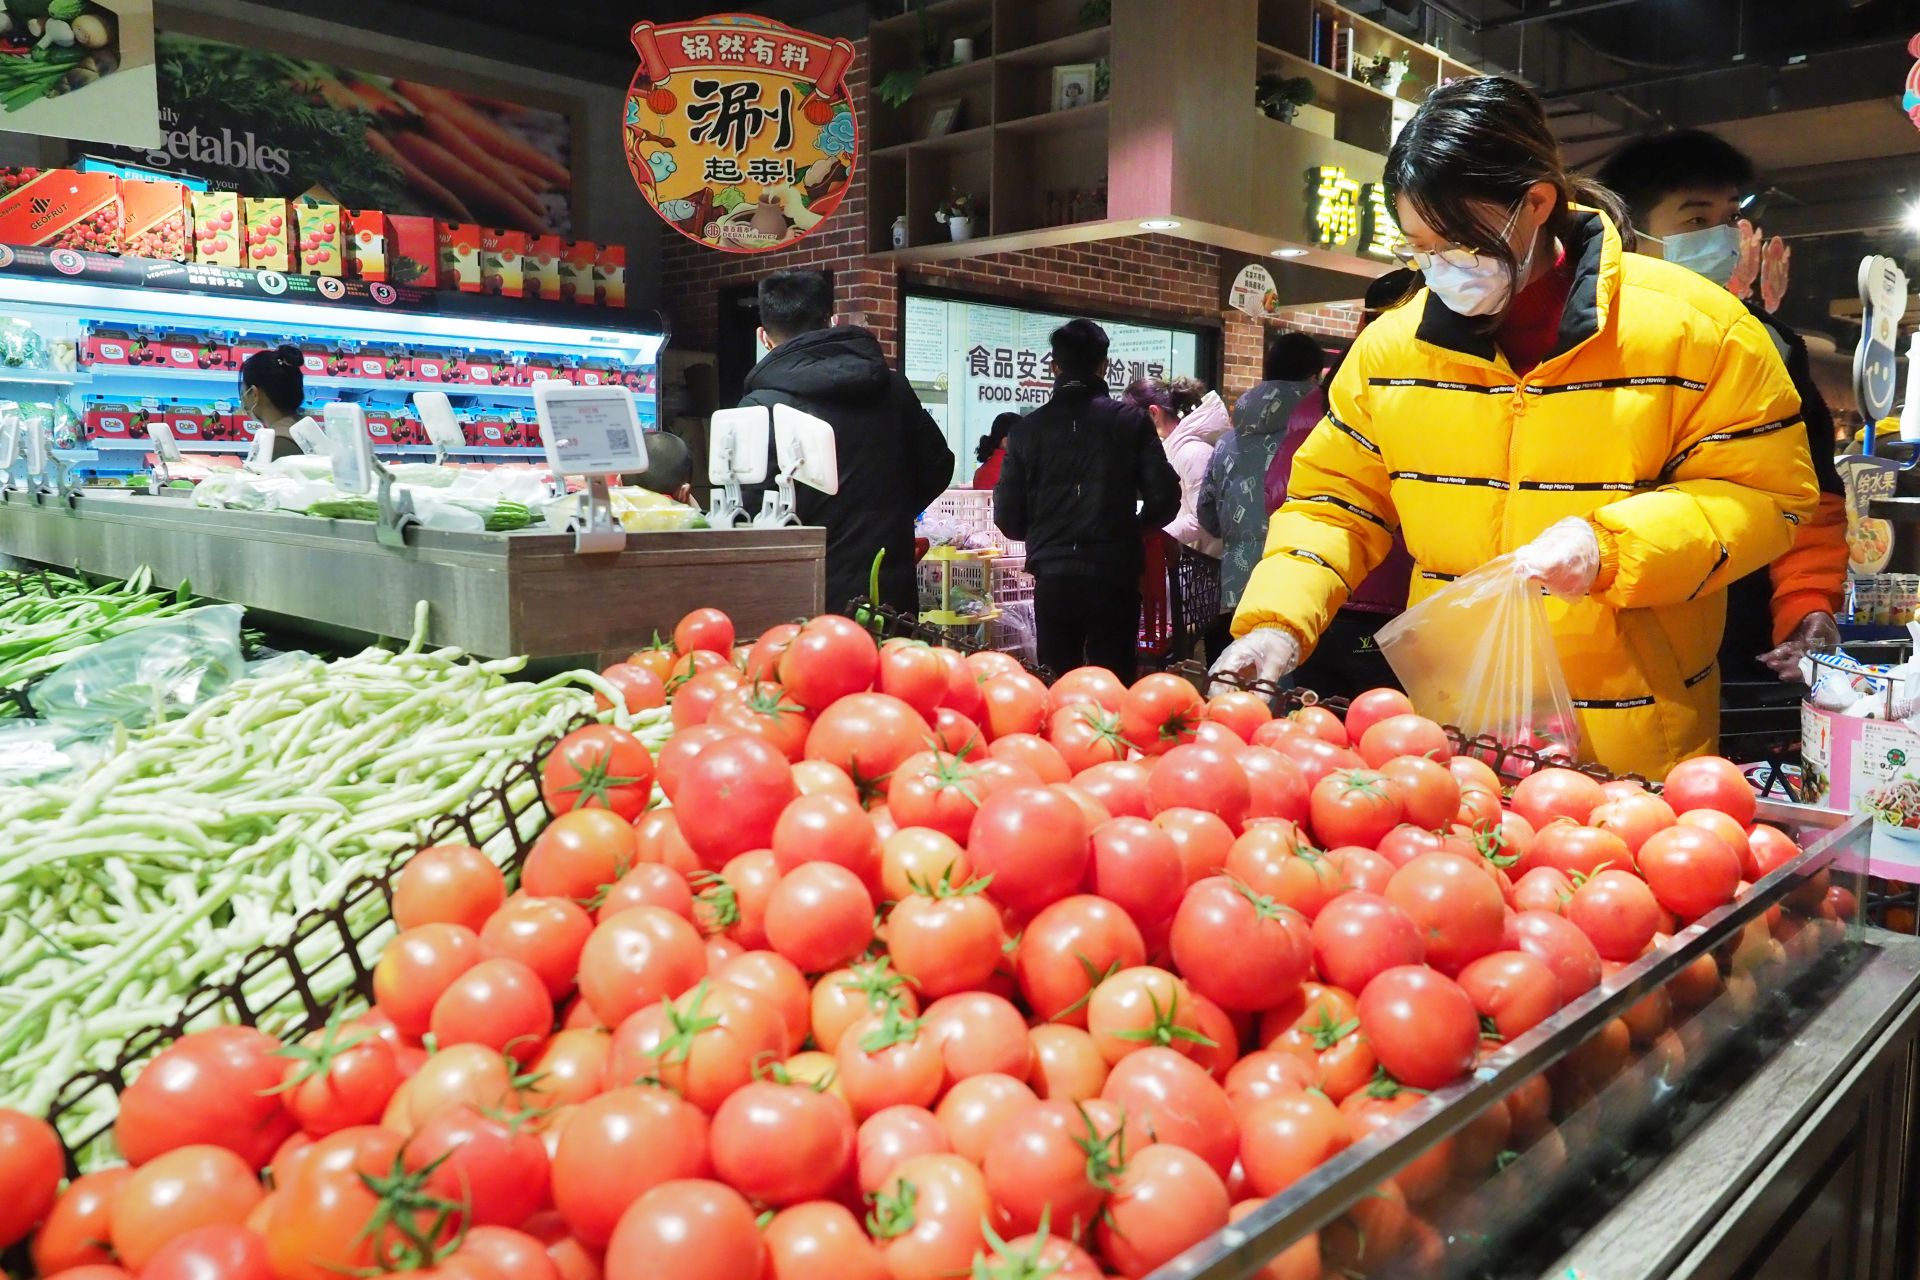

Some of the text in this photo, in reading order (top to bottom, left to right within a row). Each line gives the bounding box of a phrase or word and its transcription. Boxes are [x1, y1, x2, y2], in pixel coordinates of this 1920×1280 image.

[682, 35, 809, 71] 锅然有料
[159, 107, 181, 126] ily
[687, 80, 792, 154] 涮
[114, 125, 290, 176] getables
[215, 180, 239, 190] your
[63, 255, 73, 267] 3
[269, 276, 275, 287] 1
[327, 281, 336, 292] 2
[379, 287, 388, 297] 3
[104, 346, 121, 354] Dole
[1646, 376, 1667, 384] Moving
[979, 385, 1054, 403] FOOD SAFETY
[104, 420, 121, 428] Dole
[179, 422, 194, 431] Dole
[1857, 471, 1895, 493] 给水果
[1571, 700, 1588, 708] oving
